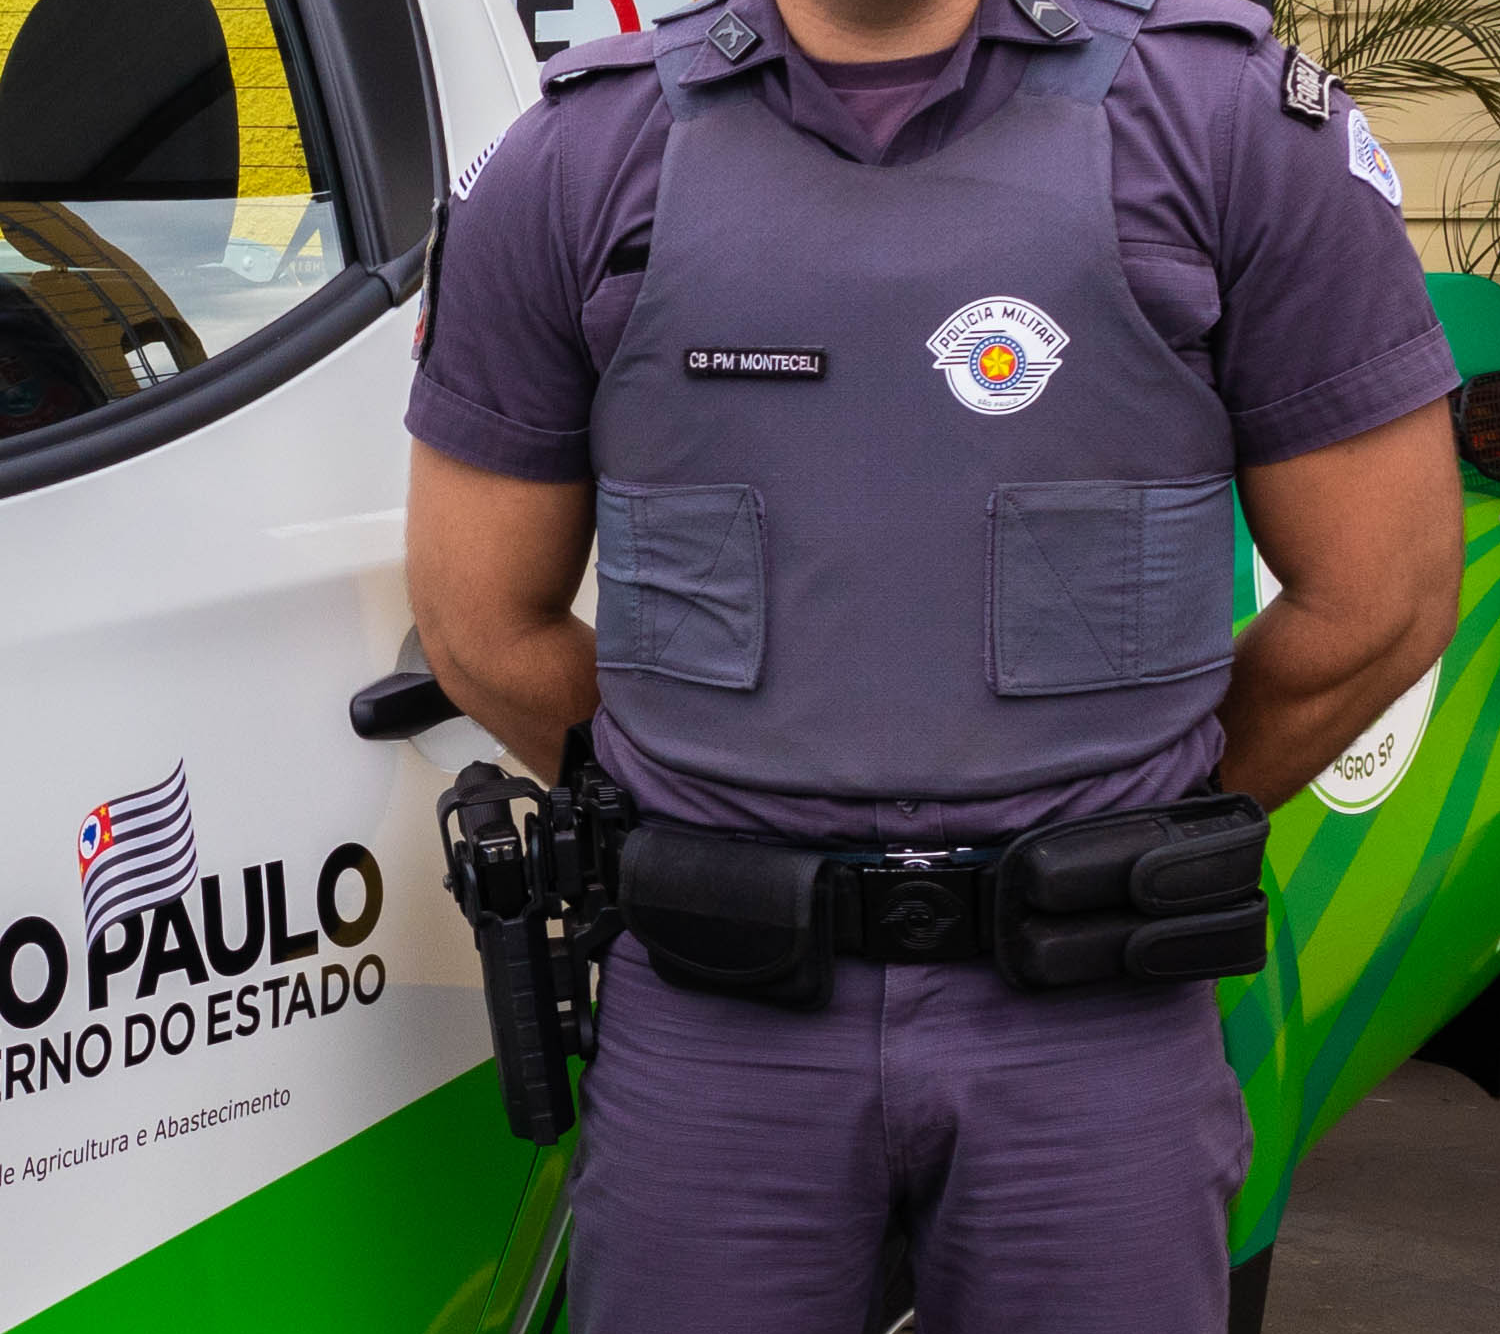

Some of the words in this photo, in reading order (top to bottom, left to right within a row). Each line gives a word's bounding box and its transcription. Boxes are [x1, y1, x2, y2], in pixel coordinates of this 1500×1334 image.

[689, 351, 708, 368] CB
[713, 353, 734, 370] PM
[740, 354, 819, 373] MONTECELI
[939, 306, 993, 349] POLÍCIA
[1002, 306, 1056, 347] MILITAR
[1333, 753, 1375, 781] AGRO
[1378, 733, 1394, 767] SP
[87, 842, 384, 1011] PAULO
[124, 1002, 196, 1068] DO
[206, 954, 386, 1046] ESTADO
[22, 1131, 129, 1184] Agricultura
[135, 1125, 147, 1148] e
[153, 1087, 291, 1142] Abastecimento
